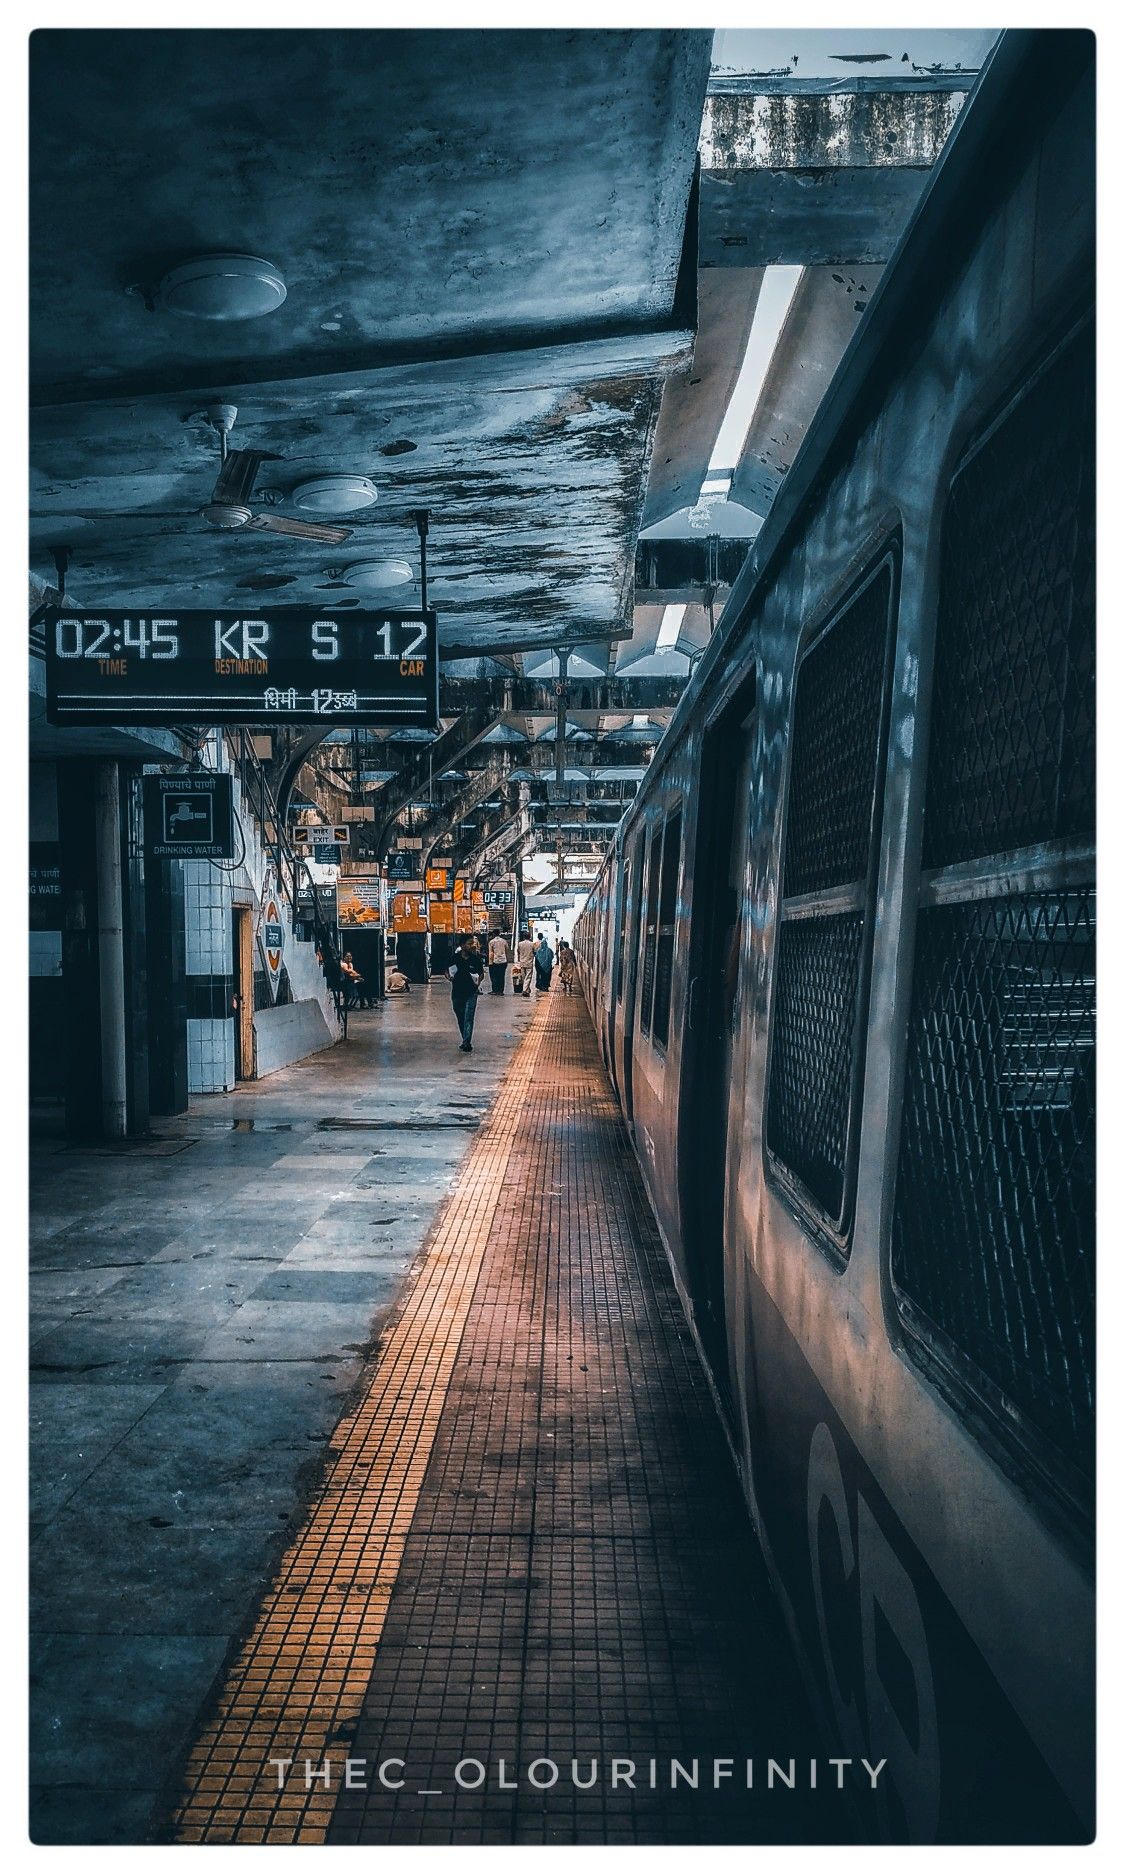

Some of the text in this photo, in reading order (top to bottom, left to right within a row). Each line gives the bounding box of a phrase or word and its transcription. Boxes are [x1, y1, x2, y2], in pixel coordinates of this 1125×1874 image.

[56, 619, 427, 660] 02:45 KR S 12
[98, 659, 425, 676] TIME DESTINATION CAR
[194, 777, 216, 790] पाणी
[153, 846, 223, 855] DRINKING WATER
